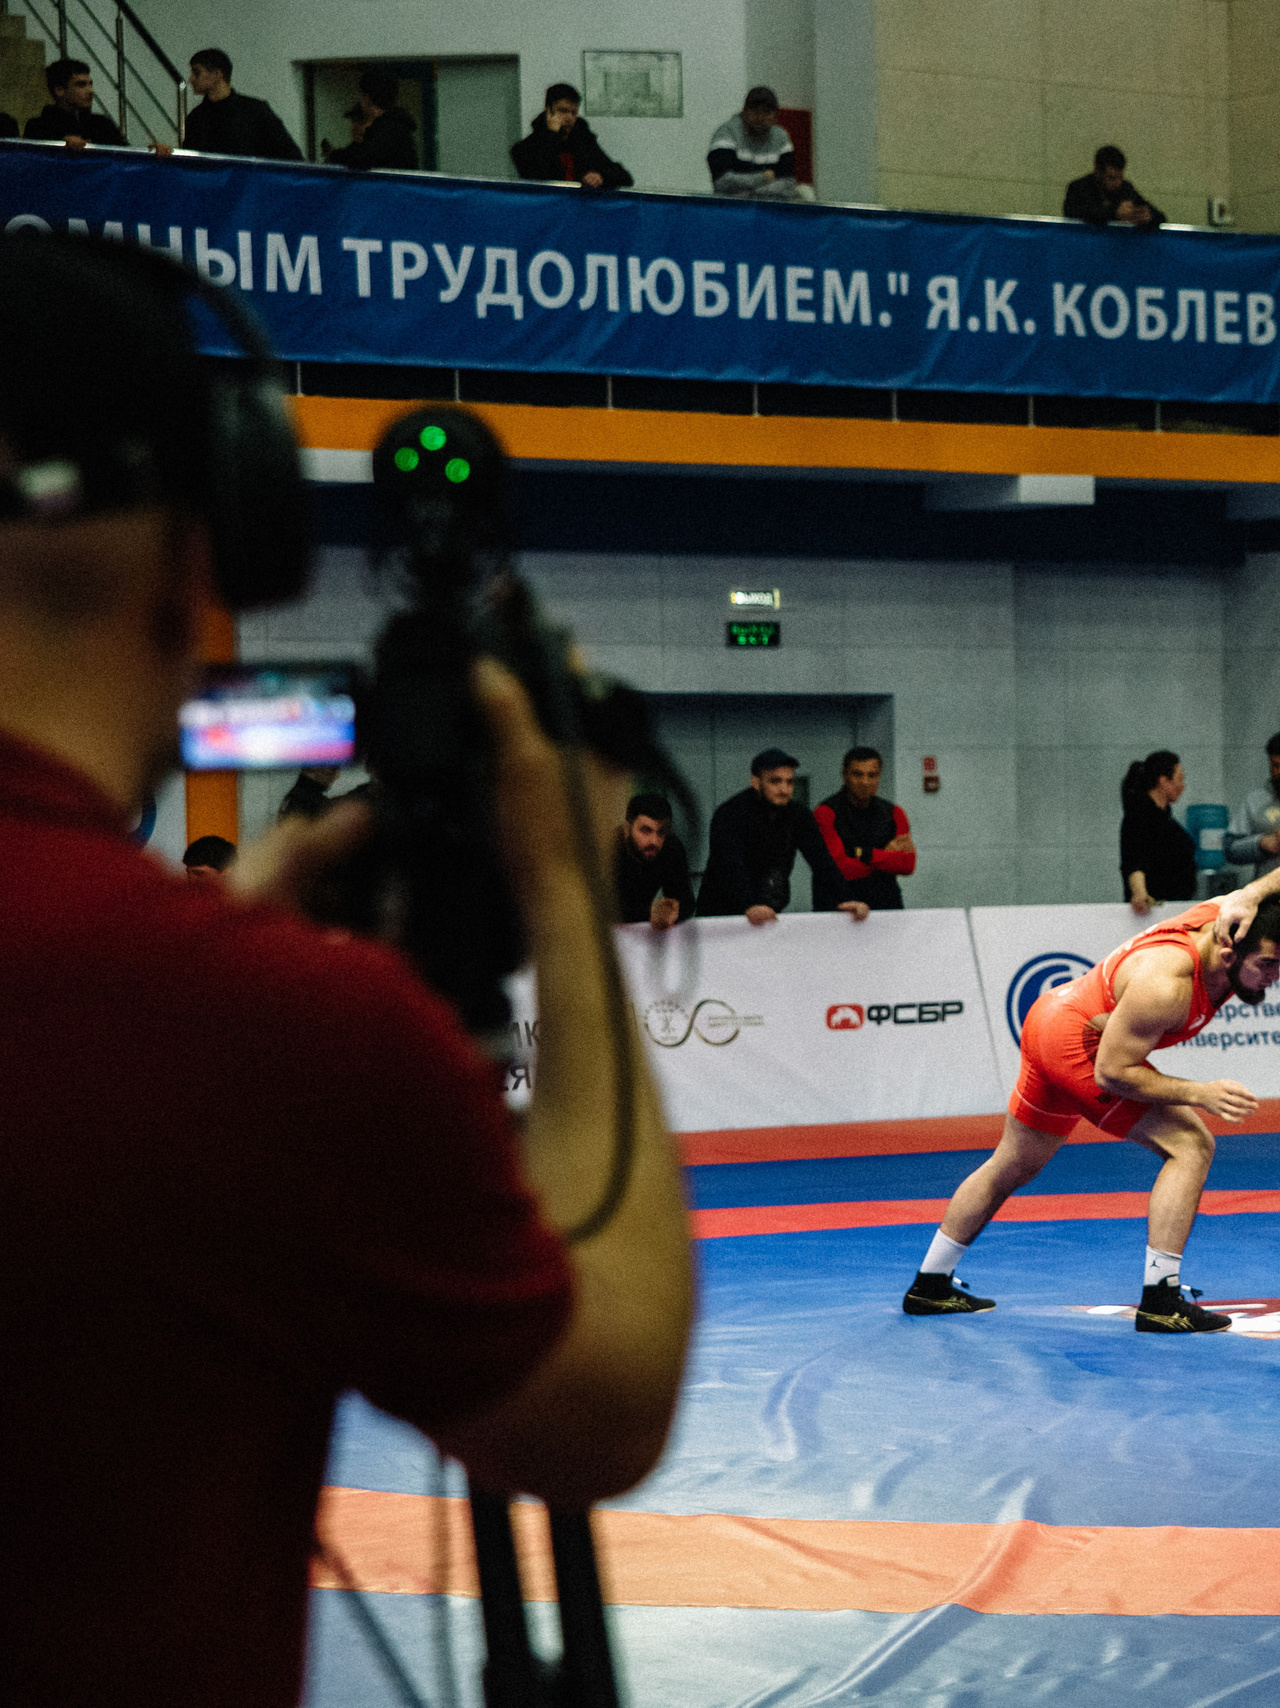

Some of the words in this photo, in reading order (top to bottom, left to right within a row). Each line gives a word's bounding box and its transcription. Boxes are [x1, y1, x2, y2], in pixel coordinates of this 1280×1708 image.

[342, 237, 909, 328] ТРУДОЛЮБИЕМ."
[926, 275, 1037, 335] Я.К.
[867, 1001, 963, 1026] ФСБР
